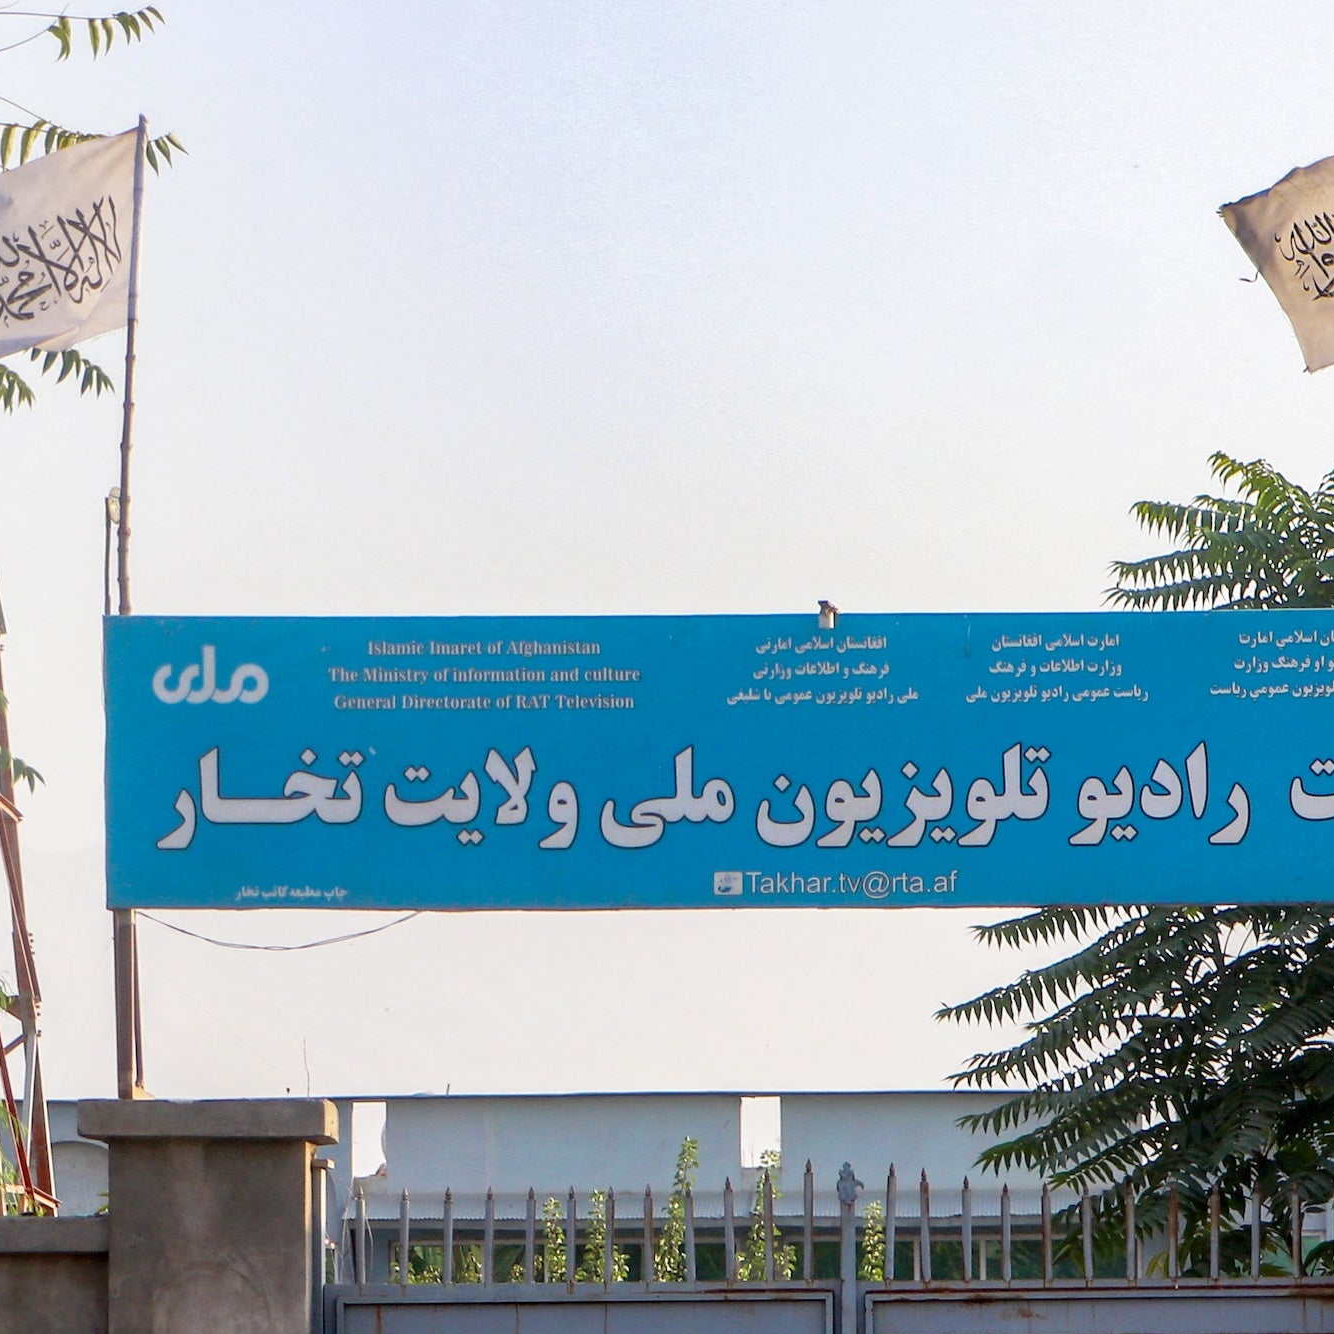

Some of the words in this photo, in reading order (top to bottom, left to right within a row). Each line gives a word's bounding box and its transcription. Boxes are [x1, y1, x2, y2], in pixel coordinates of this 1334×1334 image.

[368, 640, 424, 655] Islamic
[430, 641, 481, 655] Imaret
[487, 641, 501, 654] of
[506, 640, 601, 658] Afghanistan
[328, 667, 358, 683] The
[363, 667, 429, 685] Ministry
[433, 668, 448, 682] of
[453, 667, 545, 682] information
[550, 668, 579, 682] and
[584, 667, 640, 681] culture
[334, 695, 396, 709] General
[402, 695, 491, 709] Directorate
[496, 695, 510, 708] of
[516, 695, 551, 709] RAT
[555, 694, 634, 708] Television
[599, 744, 736, 850] ملی
[755, 741, 1052, 849] تلویزیون
[1067, 740, 1251, 847] رادیو
[745, 870, 958, 899] Takhar.tv@rta.af
